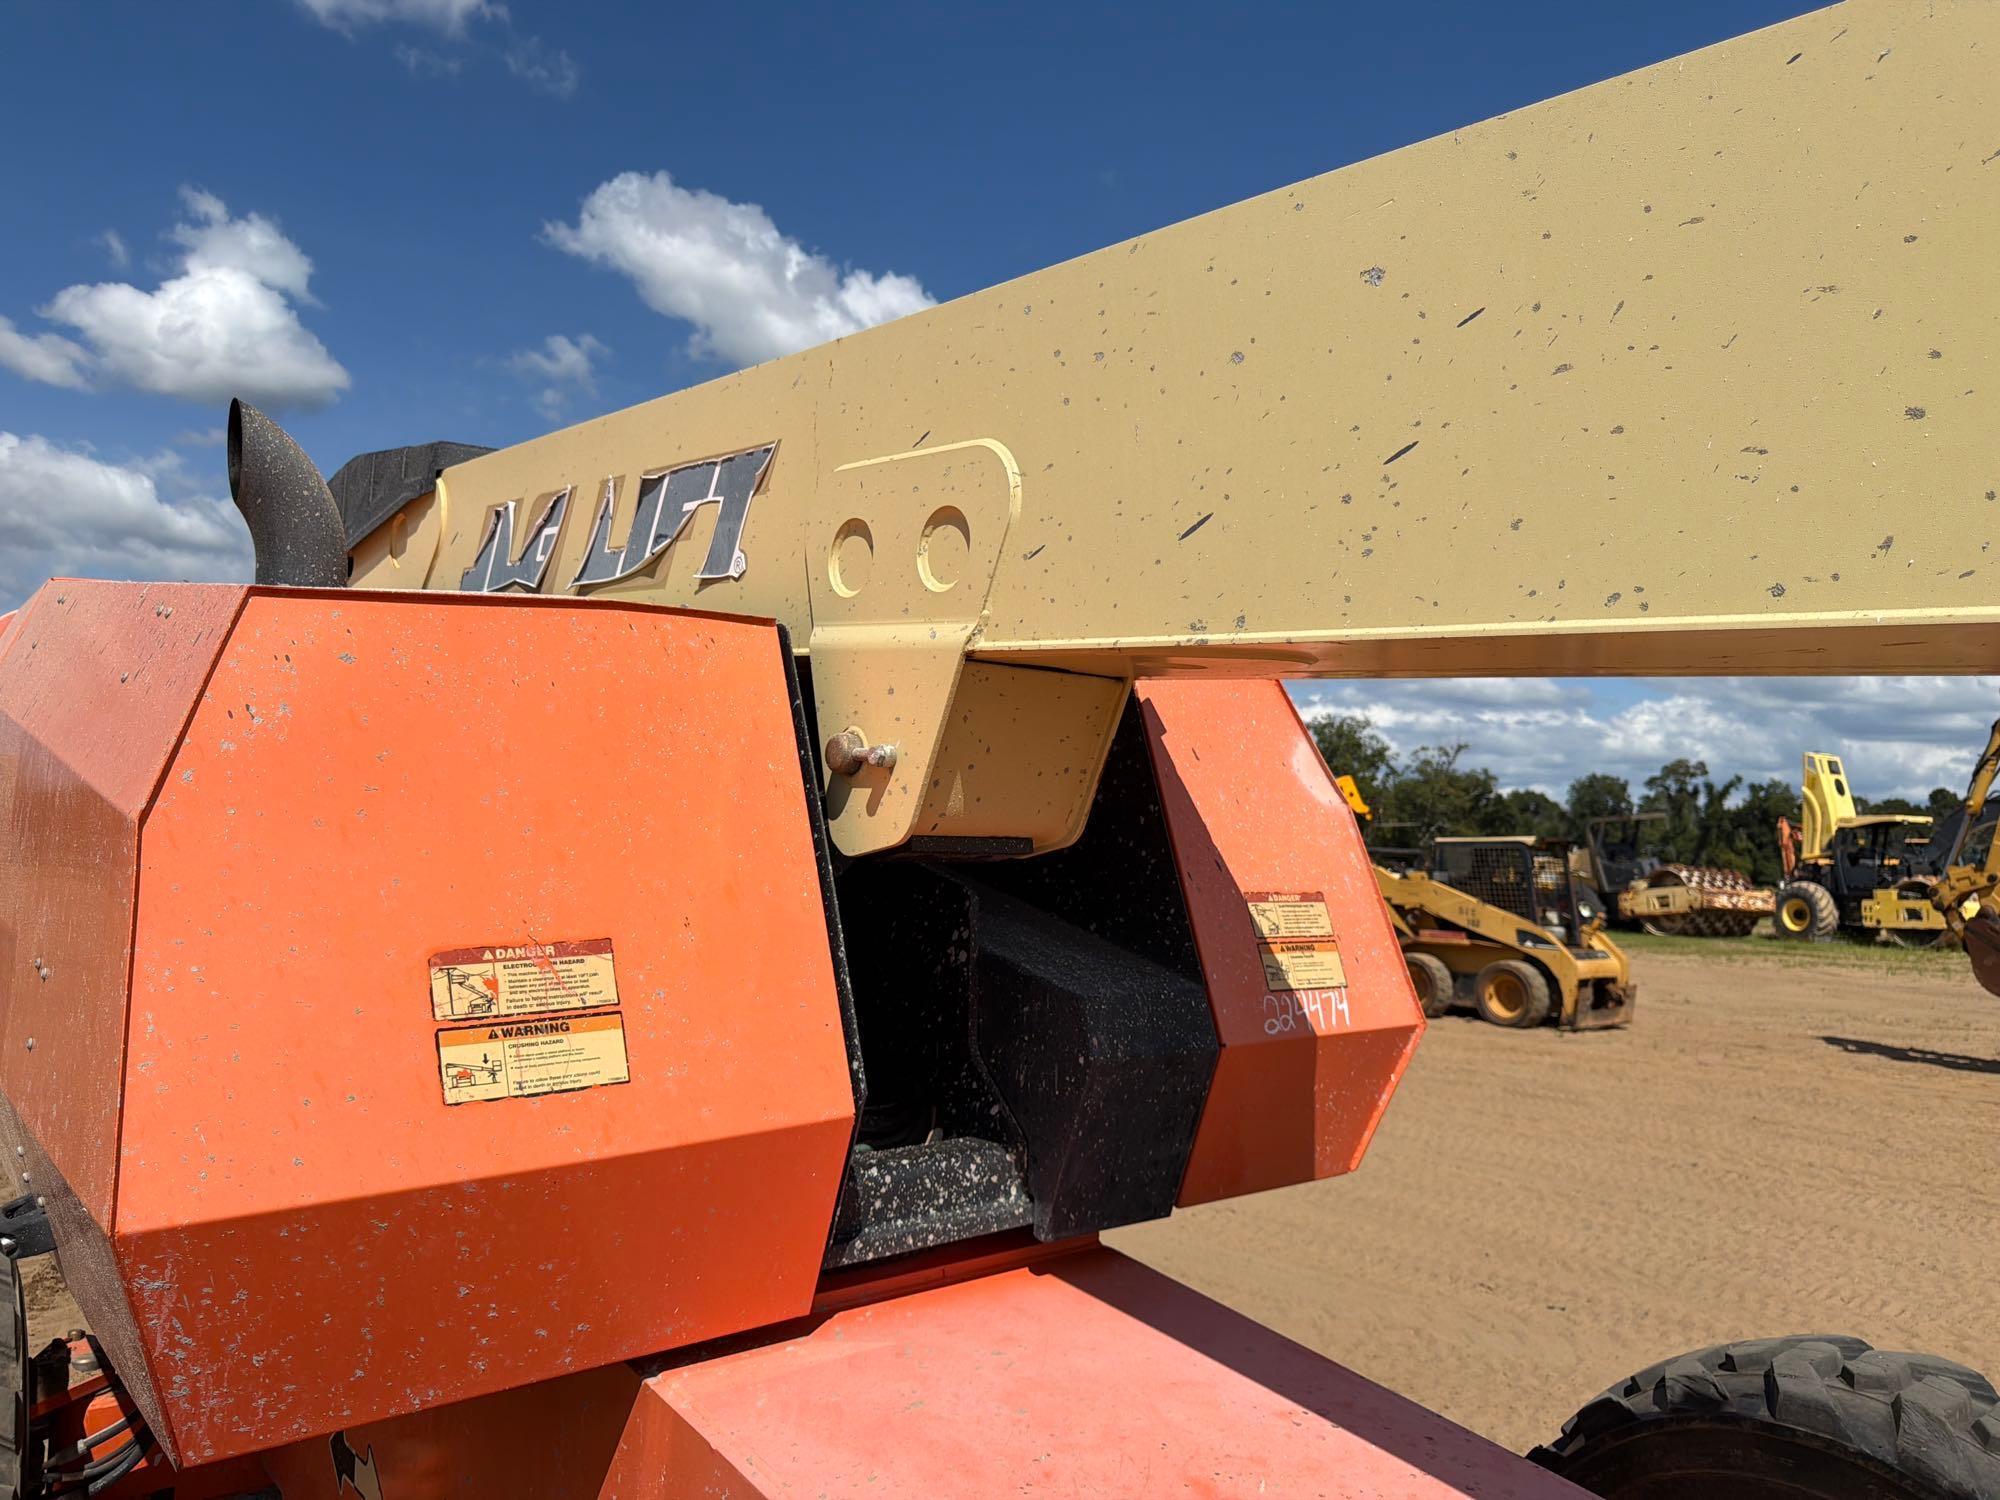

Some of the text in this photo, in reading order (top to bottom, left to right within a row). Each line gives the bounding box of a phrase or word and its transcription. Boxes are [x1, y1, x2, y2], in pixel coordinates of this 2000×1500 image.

[496, 946, 554, 959] DANGER
[1286, 944, 1315, 952] WARNING
[559, 956, 585, 965] HAZARD
[502, 1022, 570, 1038] WARNING
[508, 1041, 539, 1049] CRUSHING
